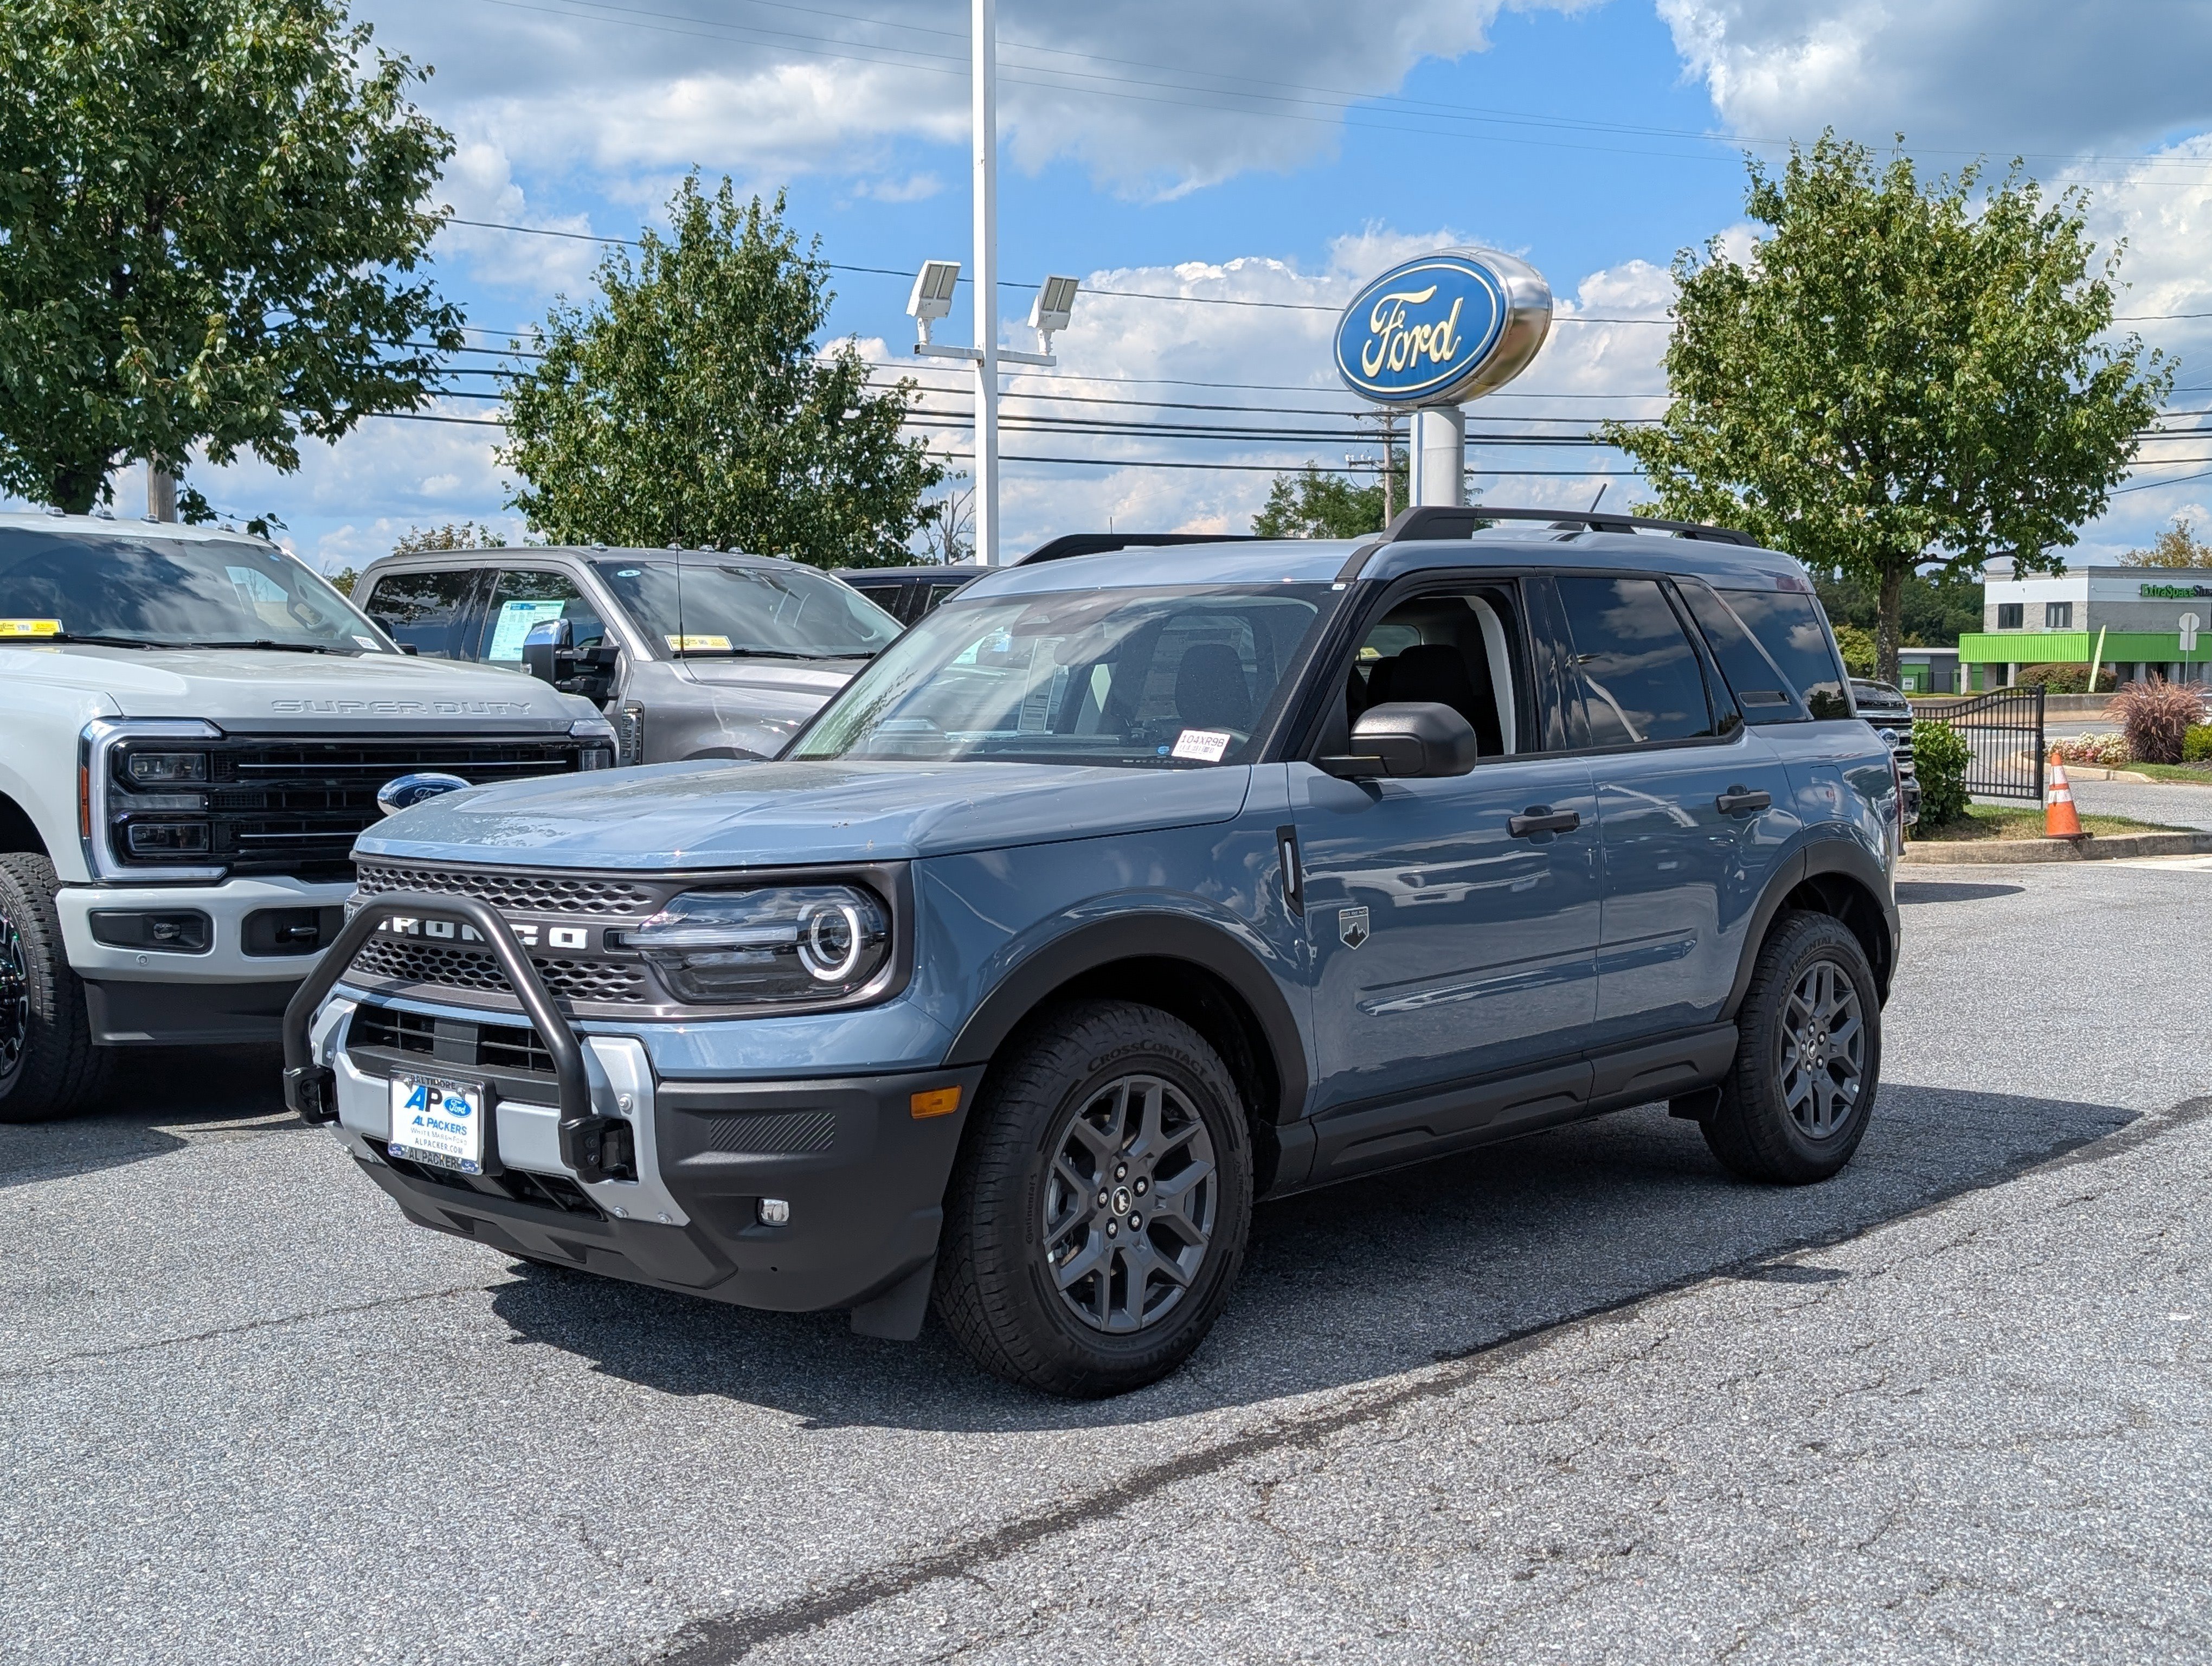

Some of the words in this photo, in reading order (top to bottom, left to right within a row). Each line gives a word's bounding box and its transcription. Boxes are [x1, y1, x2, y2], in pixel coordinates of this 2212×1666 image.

[1362, 285, 1463, 378] Ford
[271, 700, 428, 714] SUPER
[433, 701, 531, 715] DUTY
[379, 917, 588, 950] RONCO
[403, 1085, 443, 1112] AP
[449, 1099, 466, 1114] Ford
[412, 1115, 425, 1126] AL
[409, 1149, 420, 1161] AL
